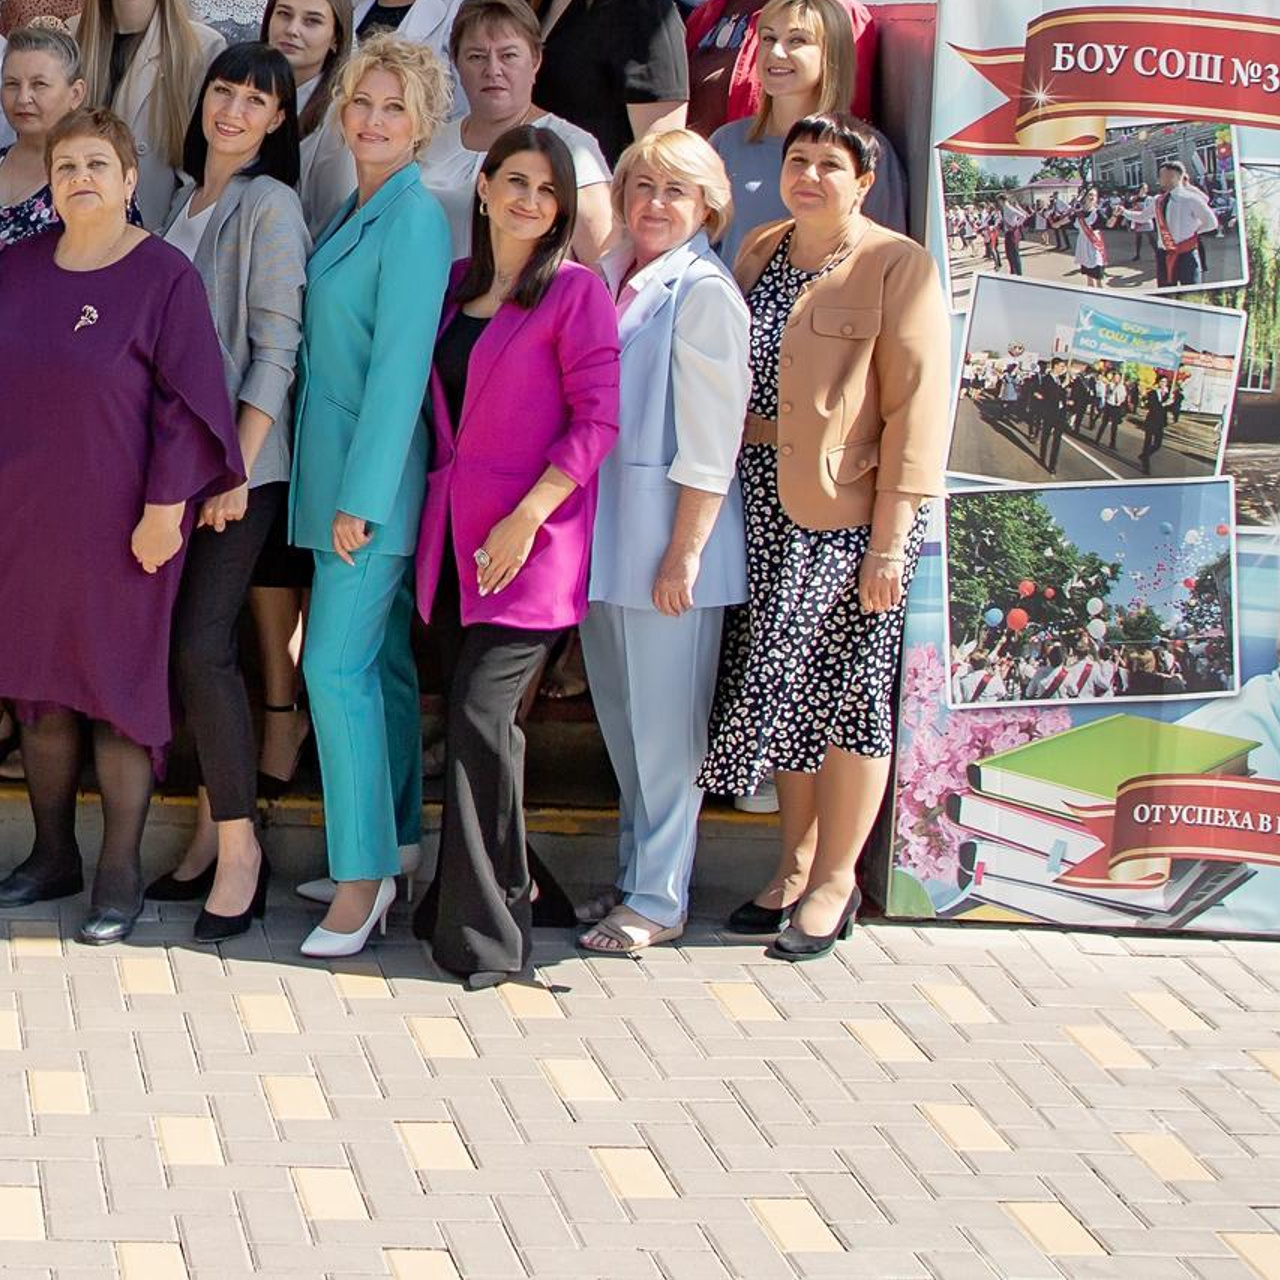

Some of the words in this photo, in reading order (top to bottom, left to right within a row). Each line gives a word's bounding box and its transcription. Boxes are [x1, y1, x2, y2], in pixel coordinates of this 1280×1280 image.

[1051, 42, 1128, 74] БОУ
[1133, 46, 1224, 84] СОШ
[1133, 804, 1166, 823] ОТ
[1167, 805, 1255, 830] УСПЕХА
[1257, 812, 1273, 832] В
